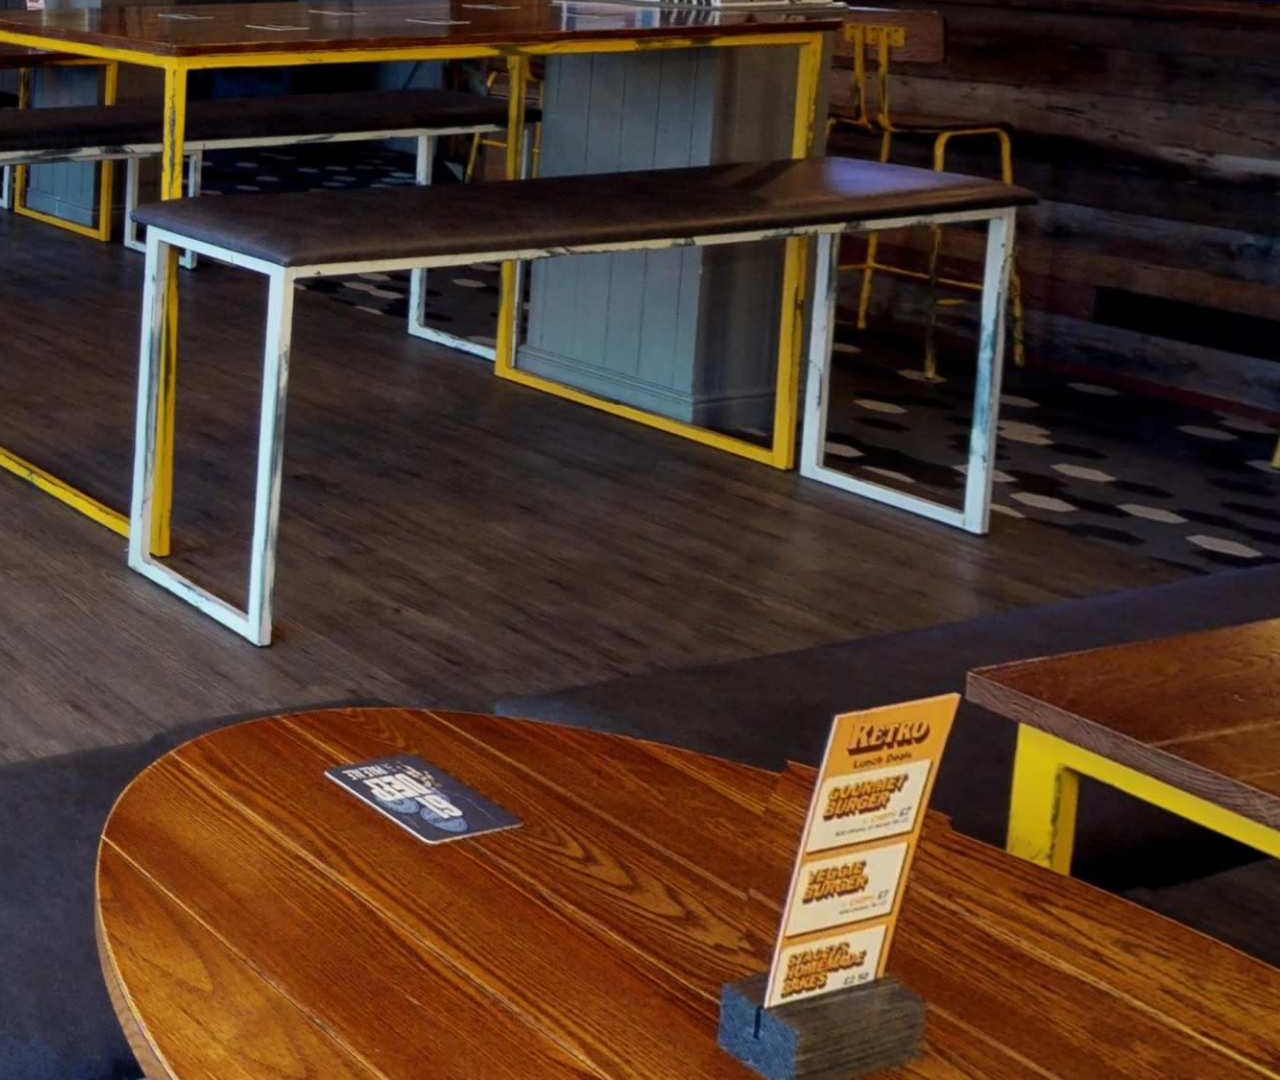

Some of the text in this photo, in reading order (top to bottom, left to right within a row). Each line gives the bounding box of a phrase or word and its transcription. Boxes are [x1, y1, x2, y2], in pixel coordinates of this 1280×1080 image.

[847, 721, 930, 756] RETRO
[828, 773, 909, 801] GOURMET
[823, 791, 891, 822] BURGER
[807, 860, 867, 886] VEGGIE
[802, 876, 869, 905] BURGER
